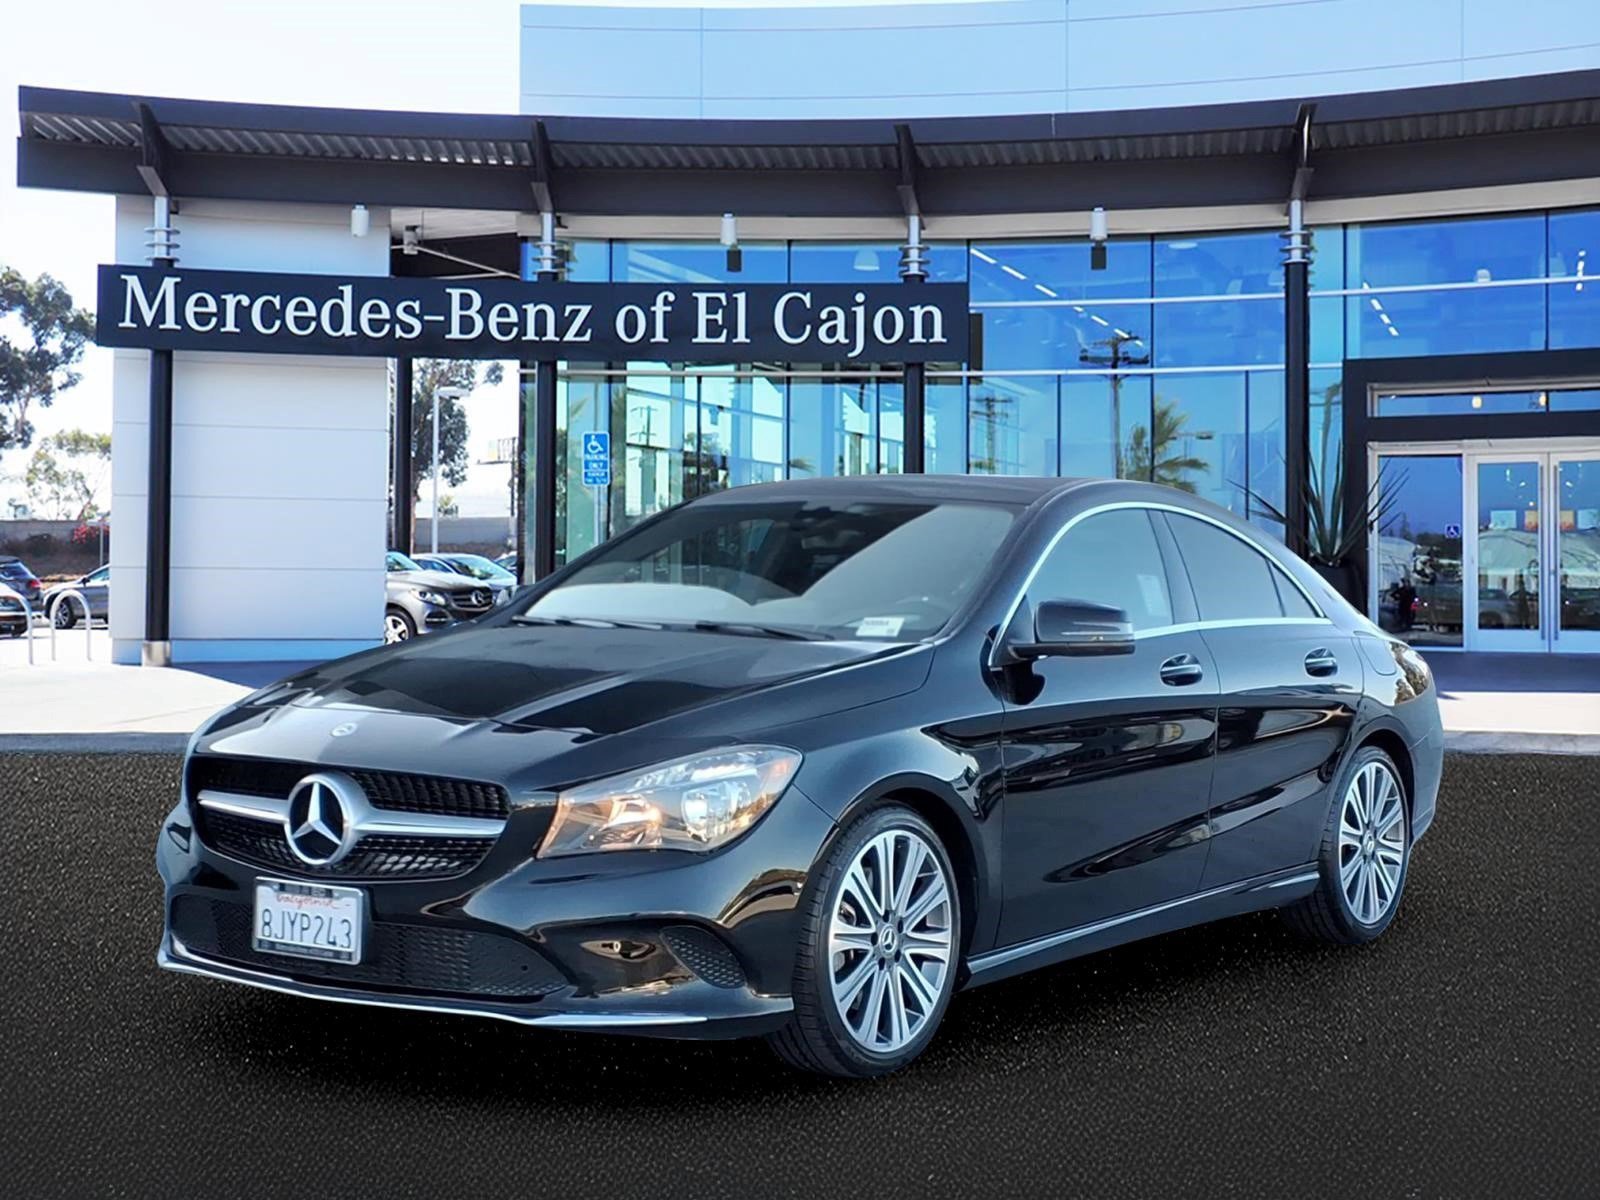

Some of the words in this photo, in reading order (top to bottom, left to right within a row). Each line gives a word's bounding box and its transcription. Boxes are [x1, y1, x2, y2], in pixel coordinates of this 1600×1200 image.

[118, 273, 593, 343] Mercedes-Benz
[614, 291, 676, 344] of
[691, 291, 751, 344] El
[773, 292, 948, 359] Cajon
[261, 908, 352, 950] 8JYP243
